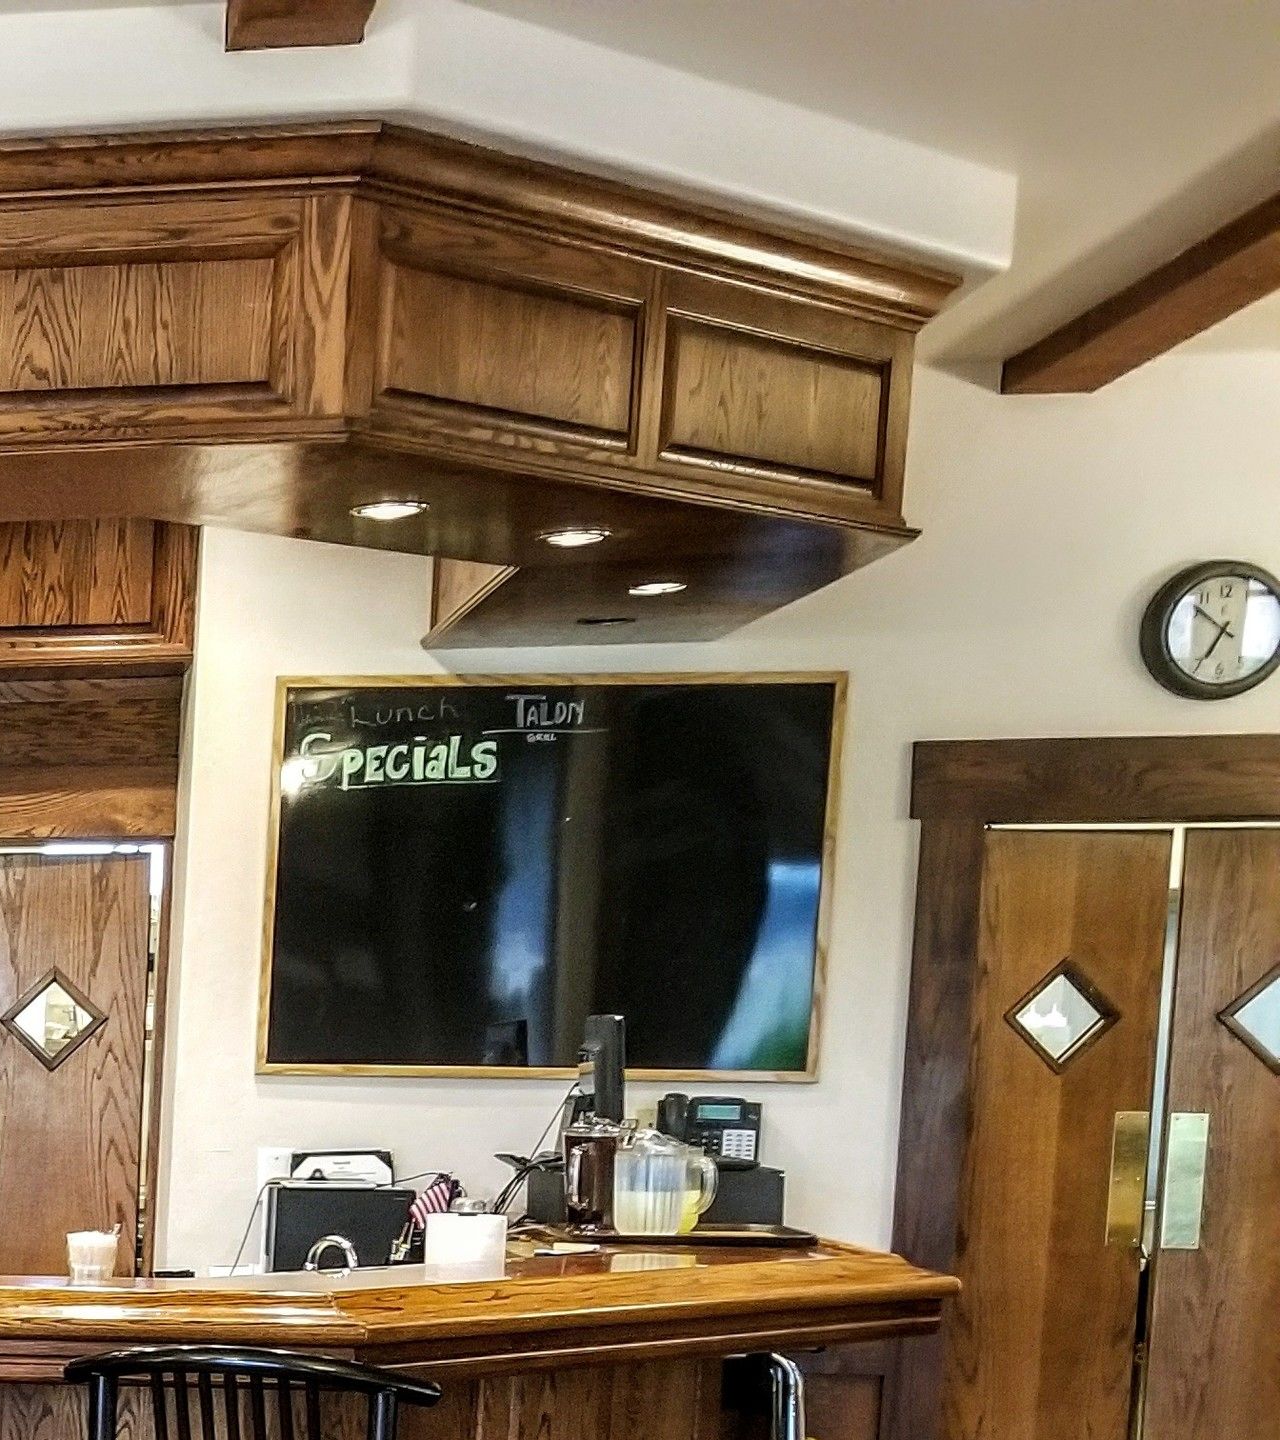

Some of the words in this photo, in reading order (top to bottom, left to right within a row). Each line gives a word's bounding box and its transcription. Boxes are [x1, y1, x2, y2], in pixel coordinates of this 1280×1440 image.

[1200, 591, 1210, 604] 11
[1220, 584, 1232, 599] 12
[349, 695, 464, 728] Lunch
